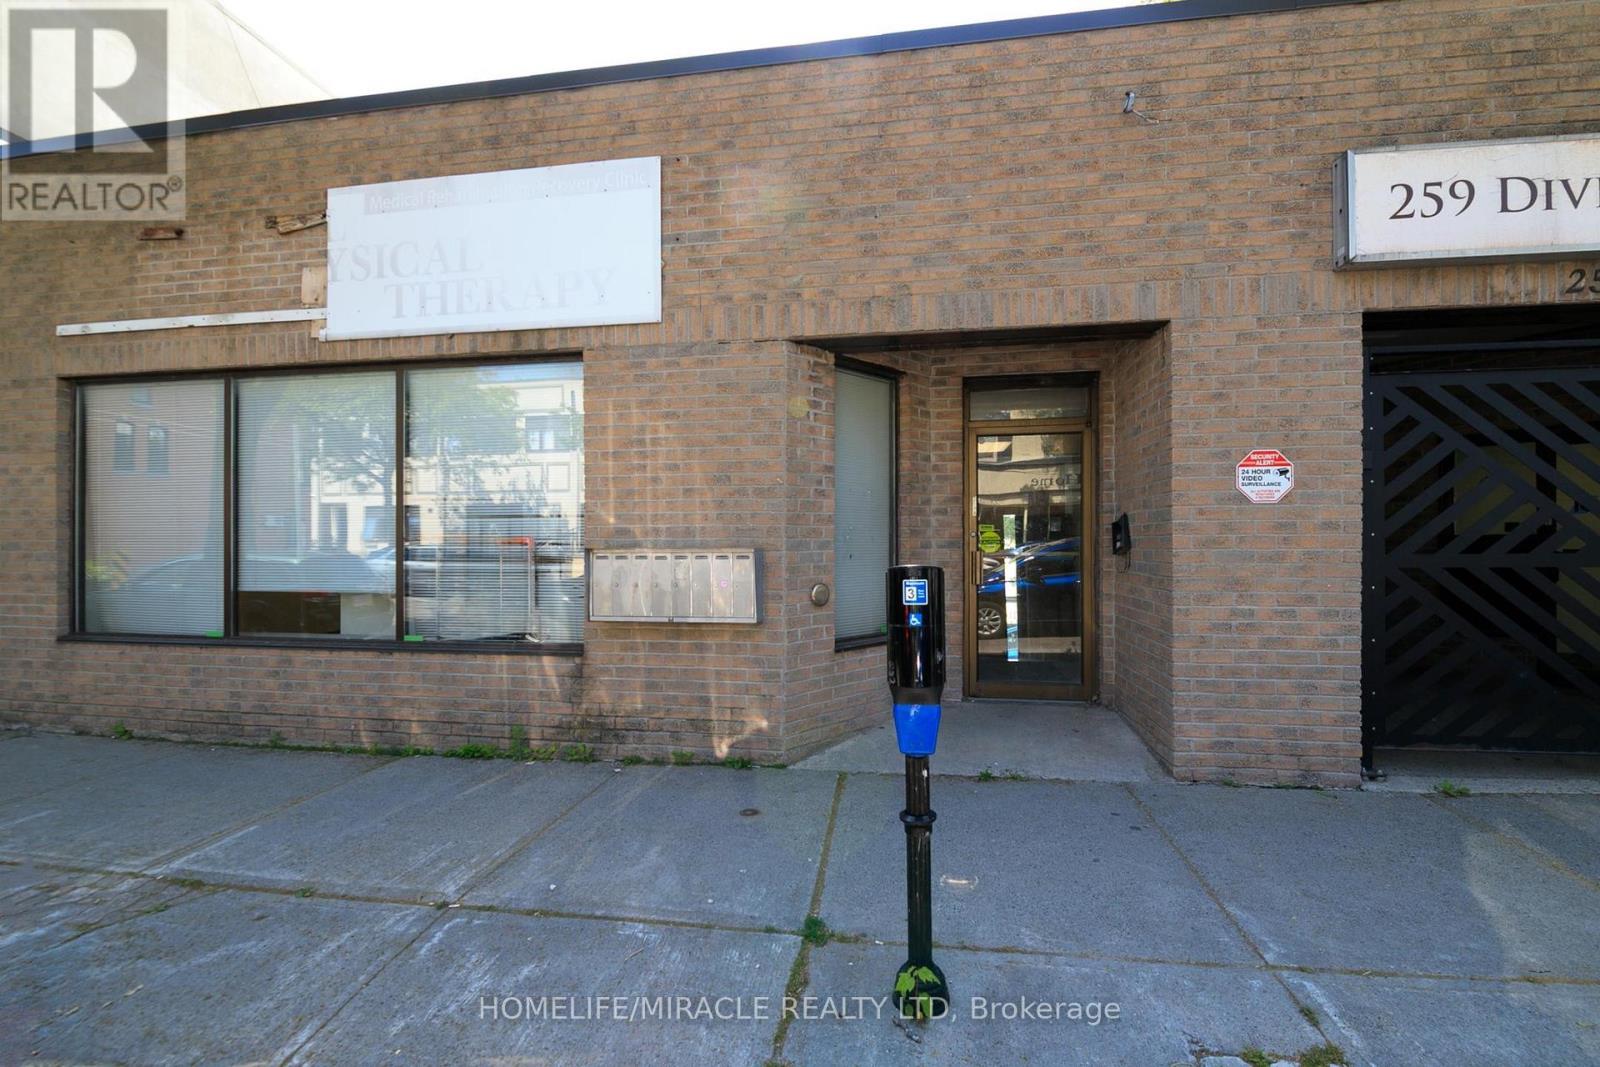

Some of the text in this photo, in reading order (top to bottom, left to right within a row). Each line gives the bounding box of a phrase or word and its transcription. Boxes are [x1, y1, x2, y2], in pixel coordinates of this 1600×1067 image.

[1389, 178, 1475, 220] 259
[384, 264, 616, 319] THERAPY
[908, 588, 915, 600] 3
